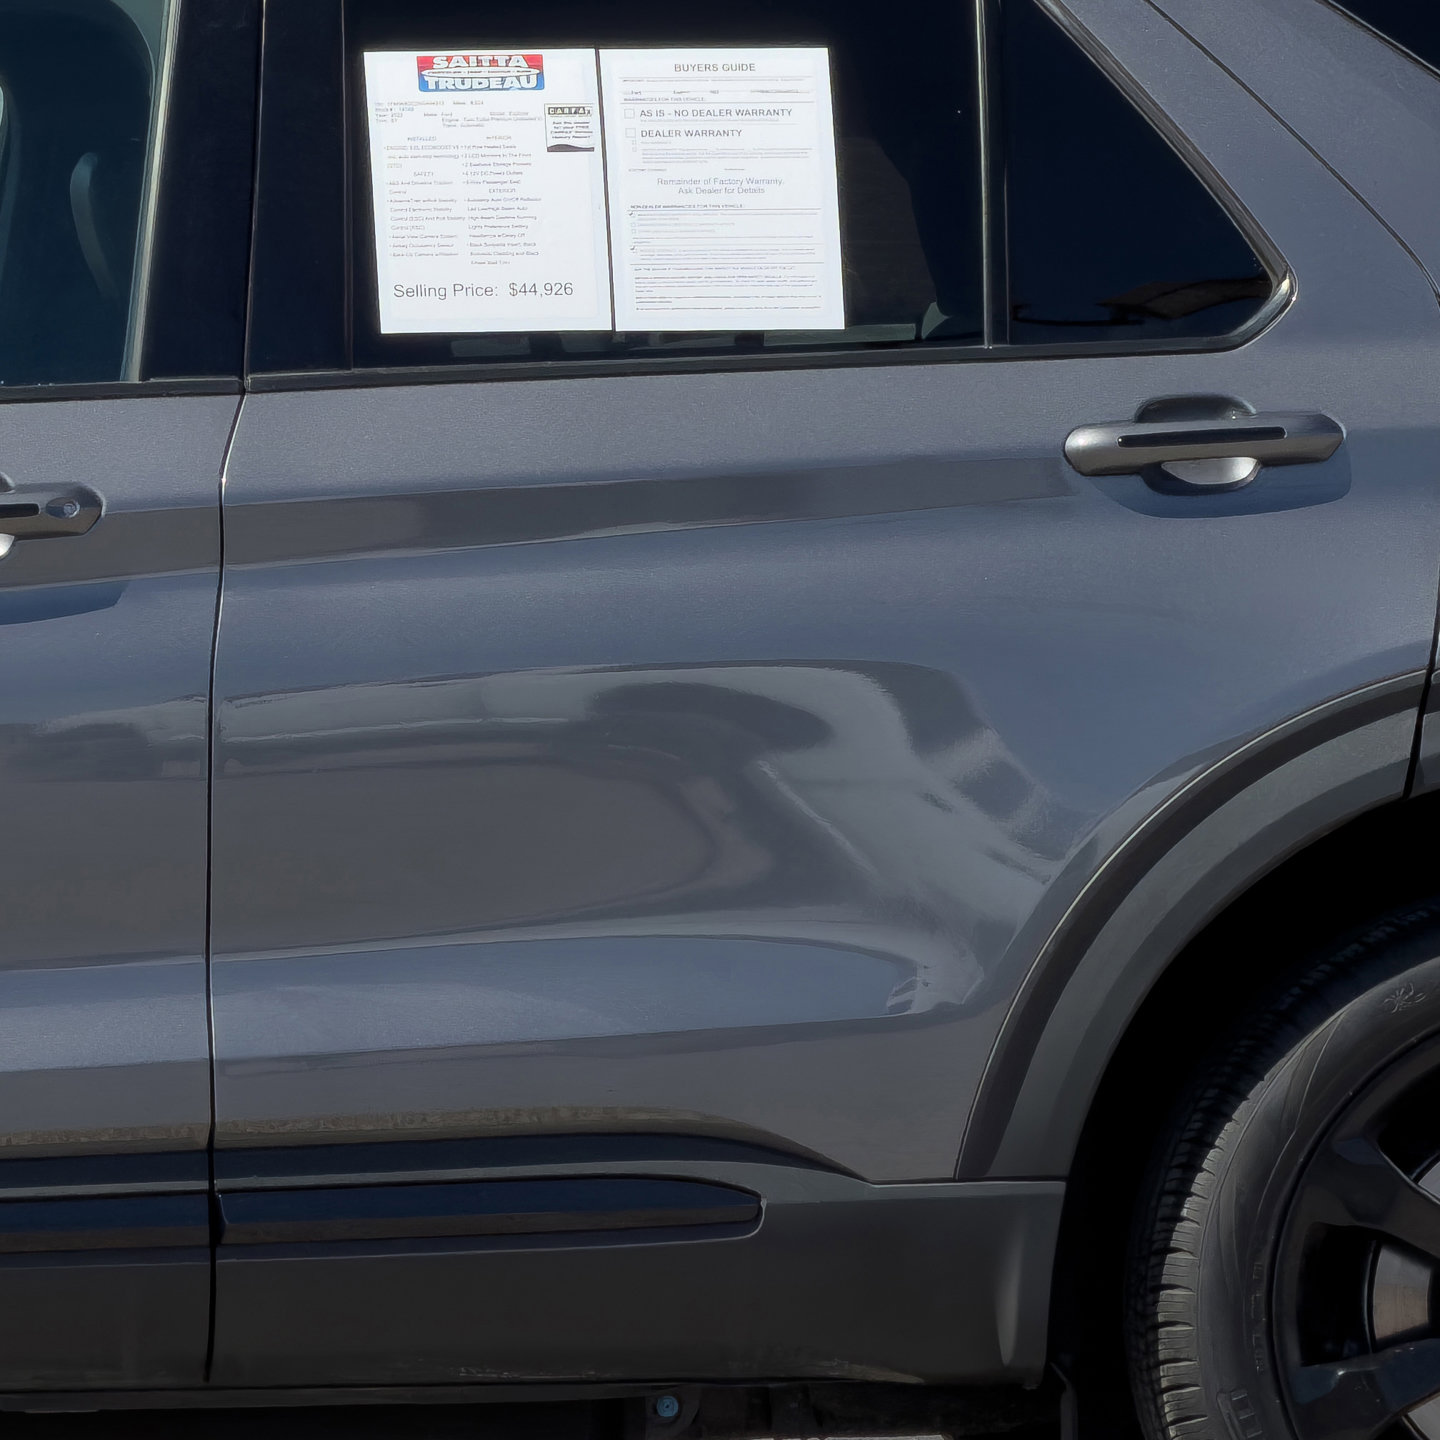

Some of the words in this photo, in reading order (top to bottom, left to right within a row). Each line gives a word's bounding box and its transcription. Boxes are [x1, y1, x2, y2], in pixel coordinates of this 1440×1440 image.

[432, 55, 529, 69] SAITTA
[674, 63, 719, 72] BUYERS
[722, 63, 756, 72] GUIDE
[424, 74, 538, 91] TRUDEAU
[639, 109, 652, 117] AS
[655, 109, 665, 117] IS
[674, 109, 689, 117] NO
[692, 109, 732, 117] DEALER
[735, 108, 793, 117] WARRANTY
[640, 129, 681, 138] DEALER
[684, 129, 742, 137] WARRANTY
[713, 178, 744, 186] Factory
[393, 283, 447, 300] Selling
[453, 283, 498, 297] Price:
[509, 282, 573, 298] $44,926
